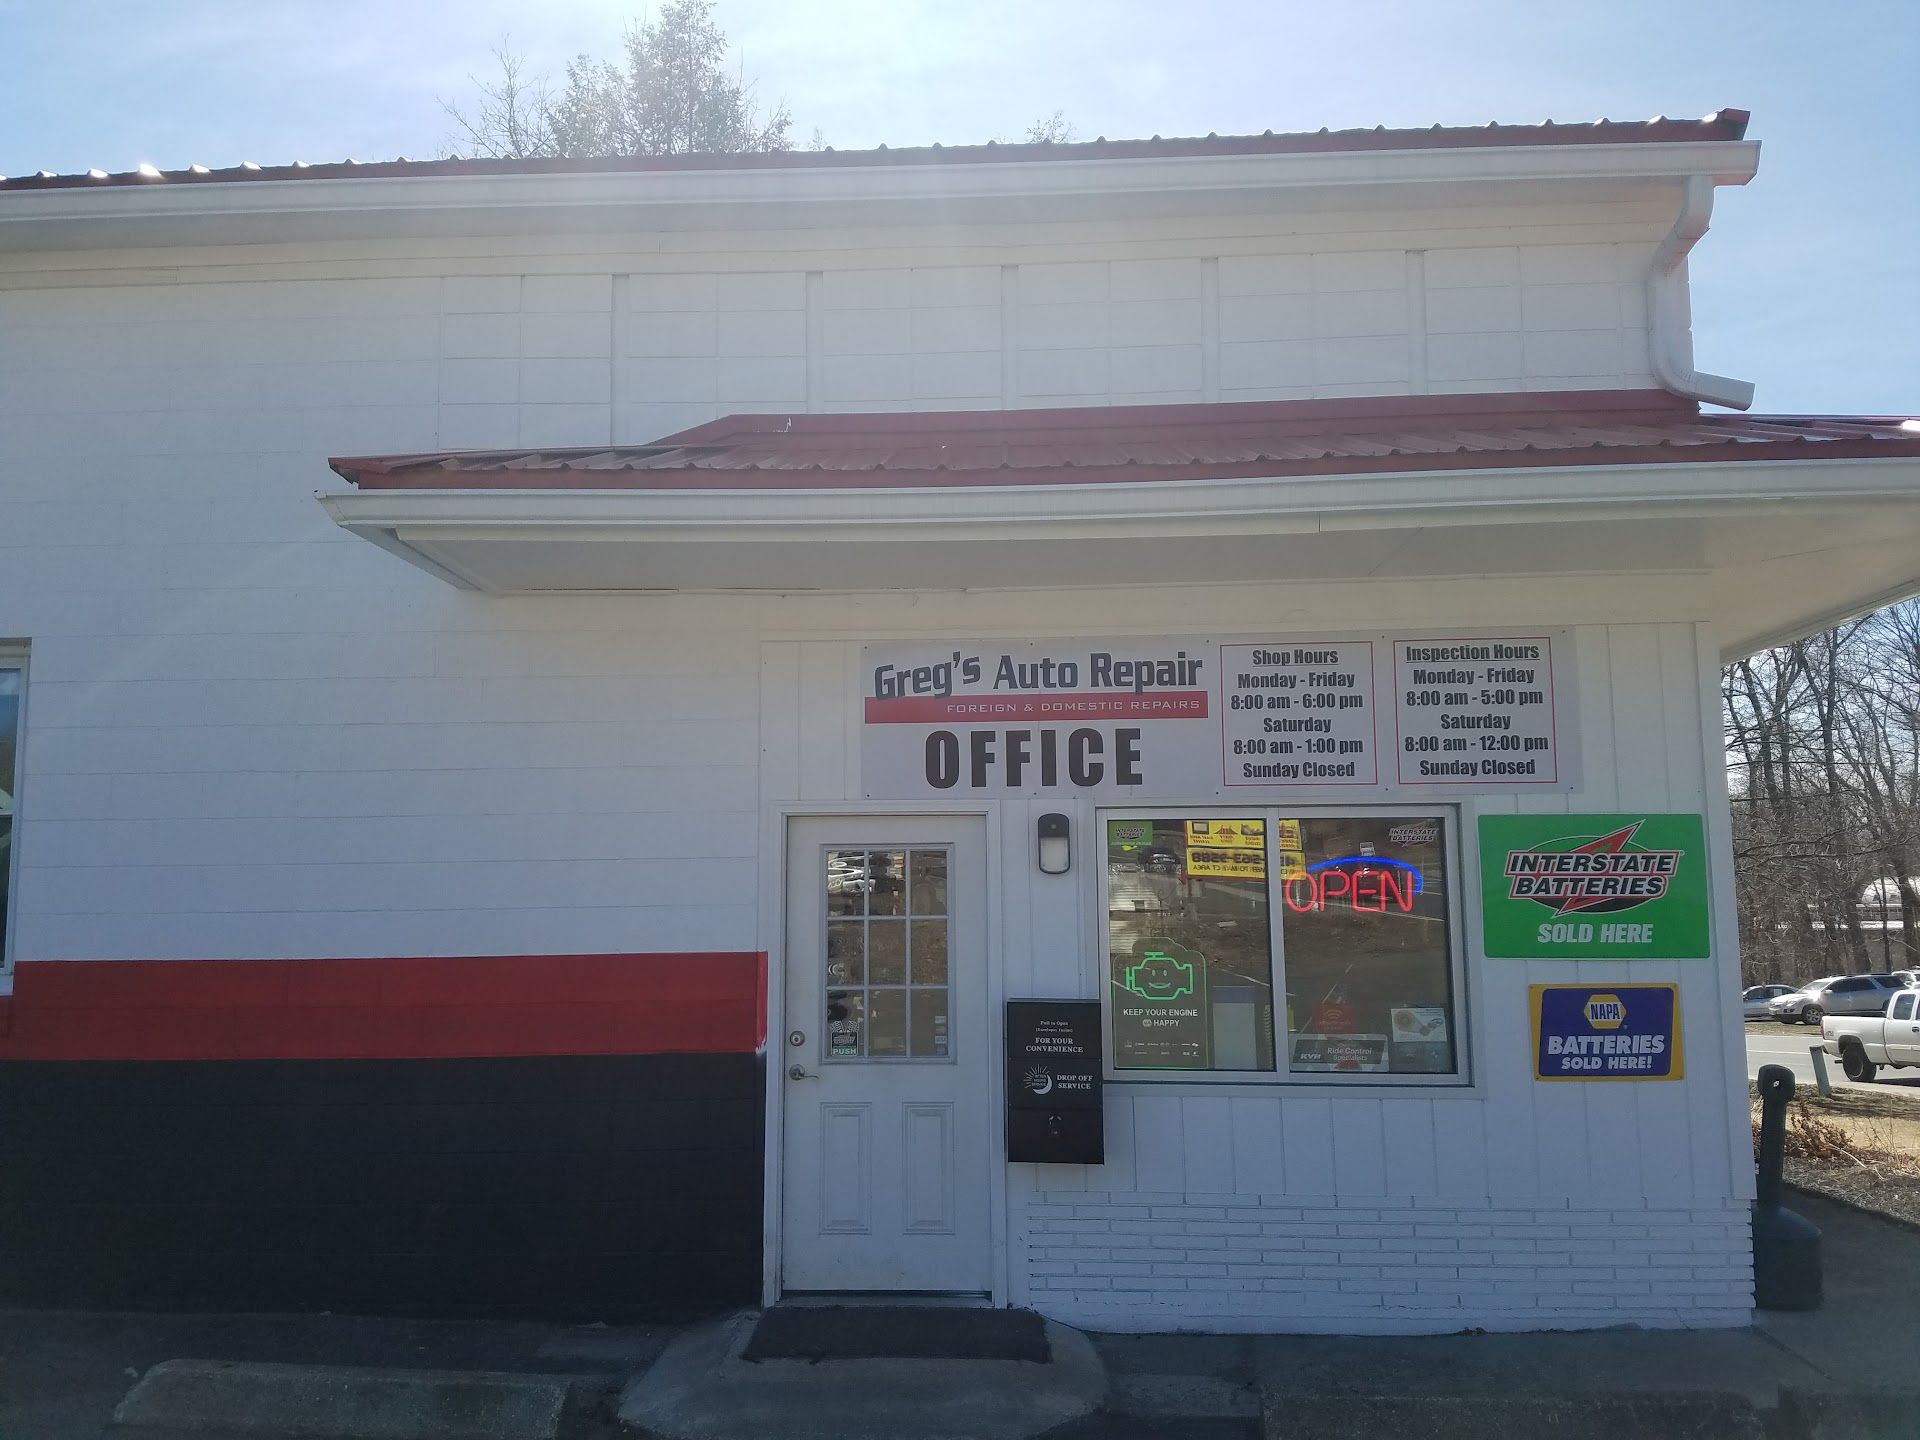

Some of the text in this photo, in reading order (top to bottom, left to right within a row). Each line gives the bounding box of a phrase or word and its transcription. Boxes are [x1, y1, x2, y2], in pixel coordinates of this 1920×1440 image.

[1252, 649, 1338, 666] Shop Hours
[1406, 643, 1540, 662] Inspection Hours
[874, 651, 1203, 699] Greg's Auto Repair
[1237, 673, 1297, 689] Monday
[1308, 672, 1355, 688] Friday
[1413, 669, 1474, 686] Monday
[1487, 668, 1535, 684] Friday
[947, 700, 1200, 713] FOREIGN & DOMESTIC REPAIRS
[1230, 694, 1264, 710] 8:00
[1267, 697, 1291, 709] am
[1302, 693, 1336, 709] 6:00
[1339, 695, 1363, 711] pm
[1406, 690, 1441, 706] 8:00
[1444, 692, 1468, 706] am
[1481, 690, 1515, 705] 5:00
[1518, 691, 1543, 706] pm
[1263, 717, 1332, 733] Saturday
[1440, 713, 1511, 731] Saturday
[1233, 739, 1266, 755] 8:00
[1269, 741, 1293, 754] am
[1305, 738, 1335, 753] 1:00
[1339, 740, 1363, 754] pm
[1405, 736, 1440, 752] 8:00
[1443, 738, 1467, 751] am
[1479, 735, 1521, 751] 12:00
[1524, 737, 1549, 752] pm
[925, 727, 1143, 789] OFFICE
[1243, 761, 1355, 779] Sunday Closed
[1420, 759, 1536, 777] Sunday Closed
[1390, 828, 1437, 836] INTERSTATE
[1509, 854, 1674, 872] INTERSTATE
[1285, 870, 1413, 912] OPEN
[1515, 876, 1665, 895] BATTERIES
[1537, 923, 1653, 943] SOLD HERE
[1169, 1009, 1198, 1017] ENGINE
[1590, 1003, 1620, 1019] NAPA
[1153, 1019, 1180, 1027] HAPPY
[1025, 1045, 1084, 1053] CONVENIENCE
[1052, 1037, 1074, 1045] YOUR
[1548, 1035, 1665, 1054] BATTERIES
[1327, 1047, 1373, 1055] Ride Control
[1561, 1055, 1652, 1069] SOLD HERE!
